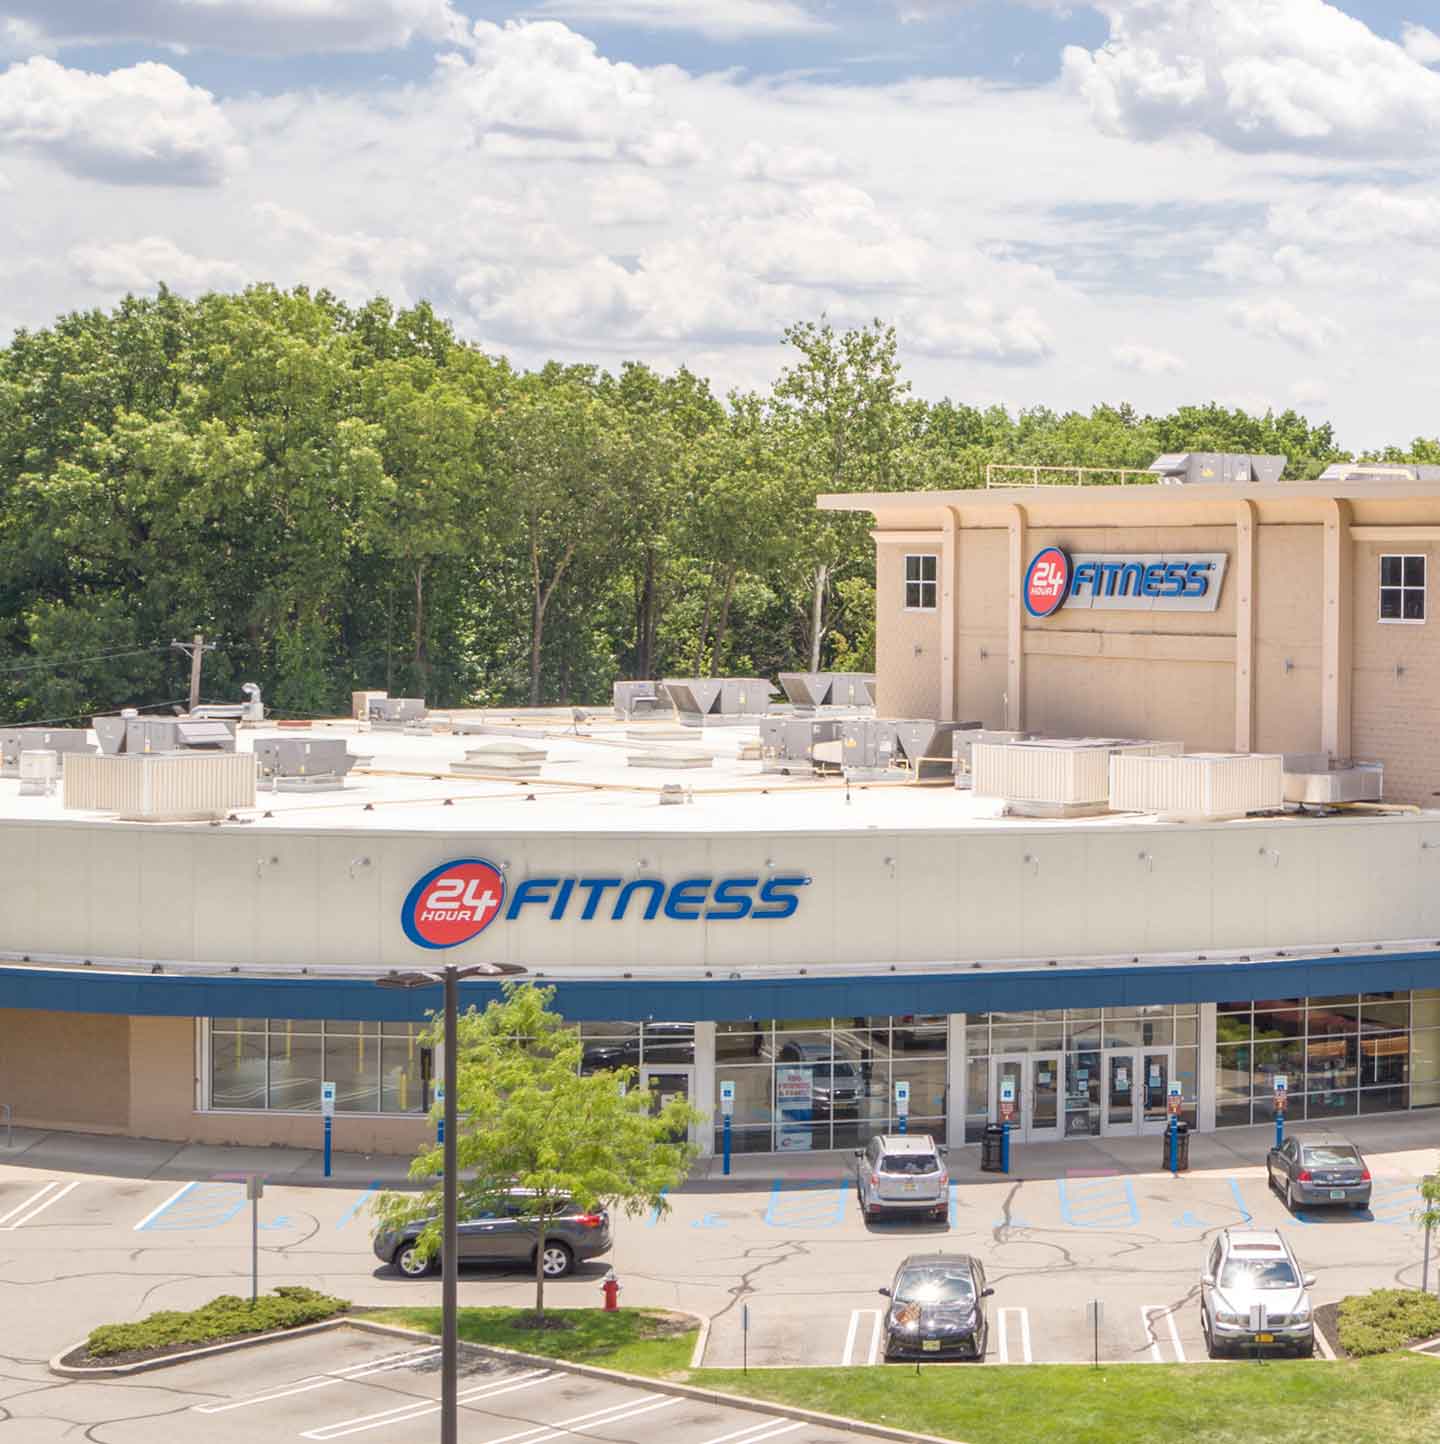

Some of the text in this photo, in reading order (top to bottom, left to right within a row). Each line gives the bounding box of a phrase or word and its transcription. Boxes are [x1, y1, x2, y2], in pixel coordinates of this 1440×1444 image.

[1030, 586, 1053, 596] HOUR
[1033, 562, 1064, 596] 24
[1071, 562, 1211, 597] FITNESS
[420, 910, 472, 921] HOUR
[426, 878, 497, 921] 24
[505, 877, 804, 920] FITNESS
